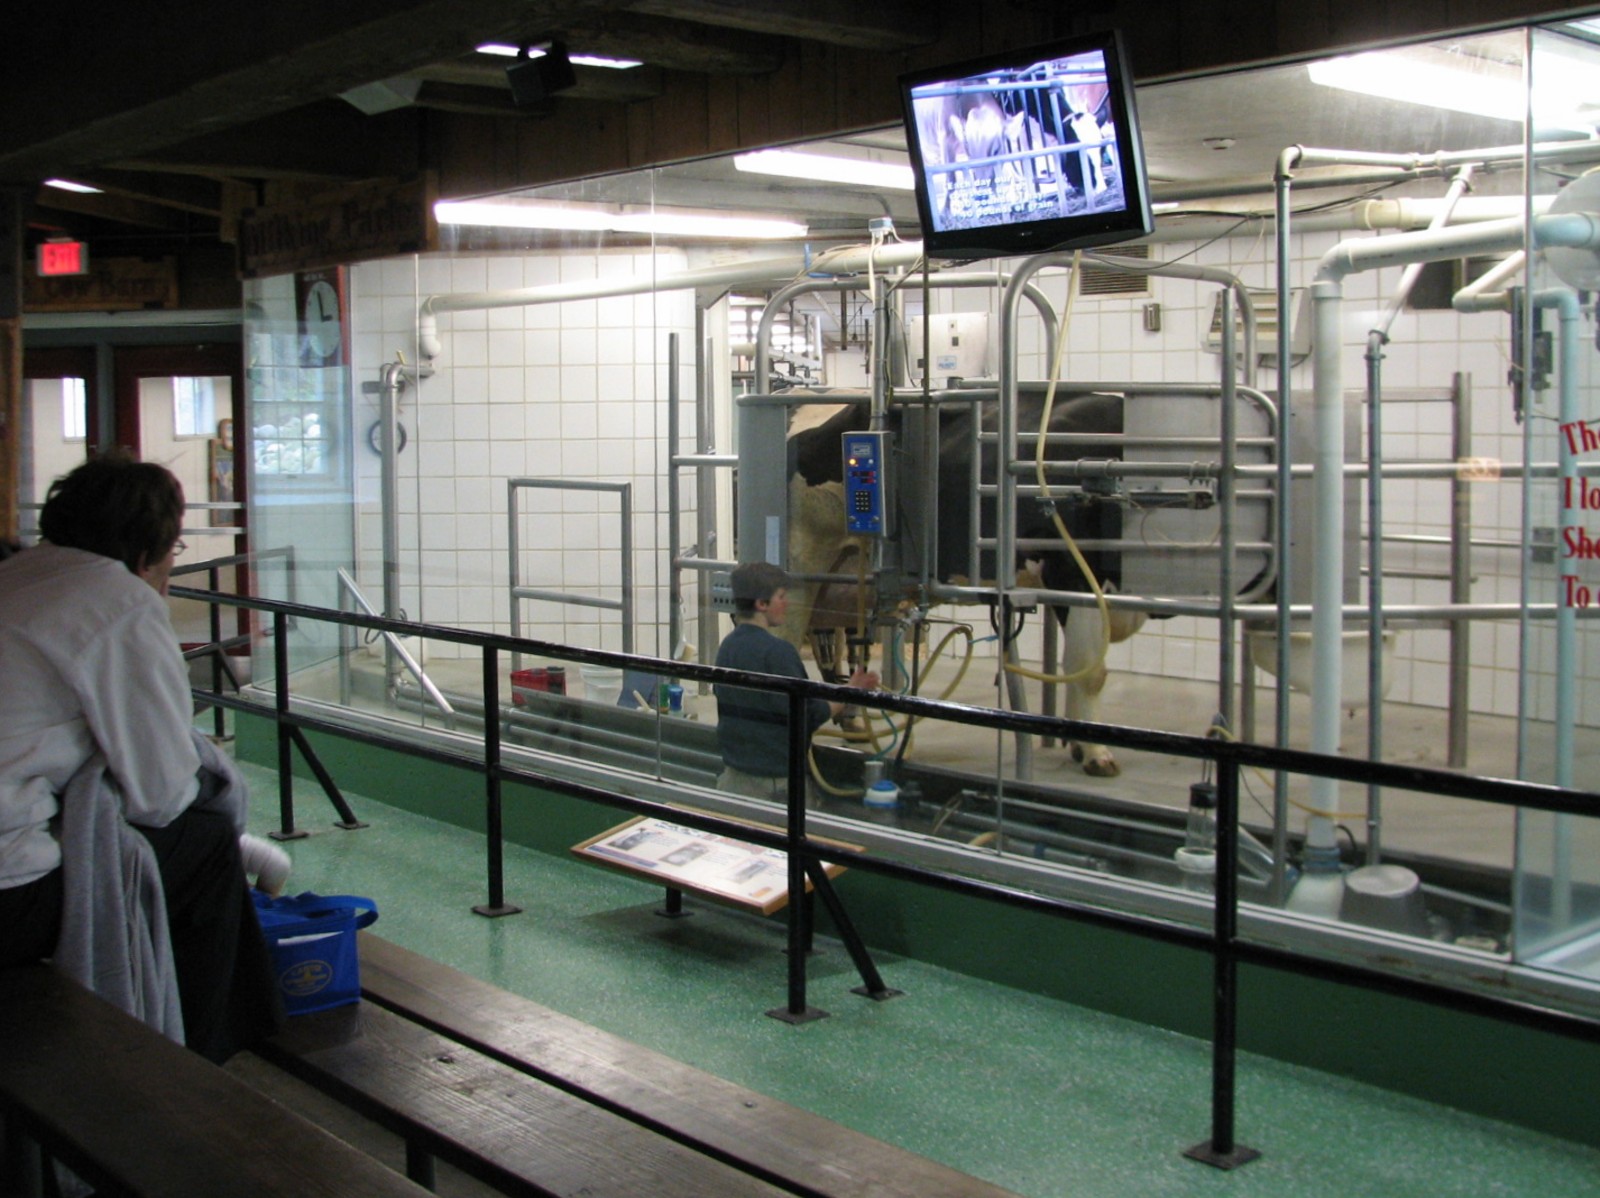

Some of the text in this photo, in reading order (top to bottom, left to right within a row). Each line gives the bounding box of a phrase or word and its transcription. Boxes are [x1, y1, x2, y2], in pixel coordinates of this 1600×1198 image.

[973, 178, 990, 187] day
[1563, 476, 1572, 509] I
[1561, 574, 1591, 609] To
